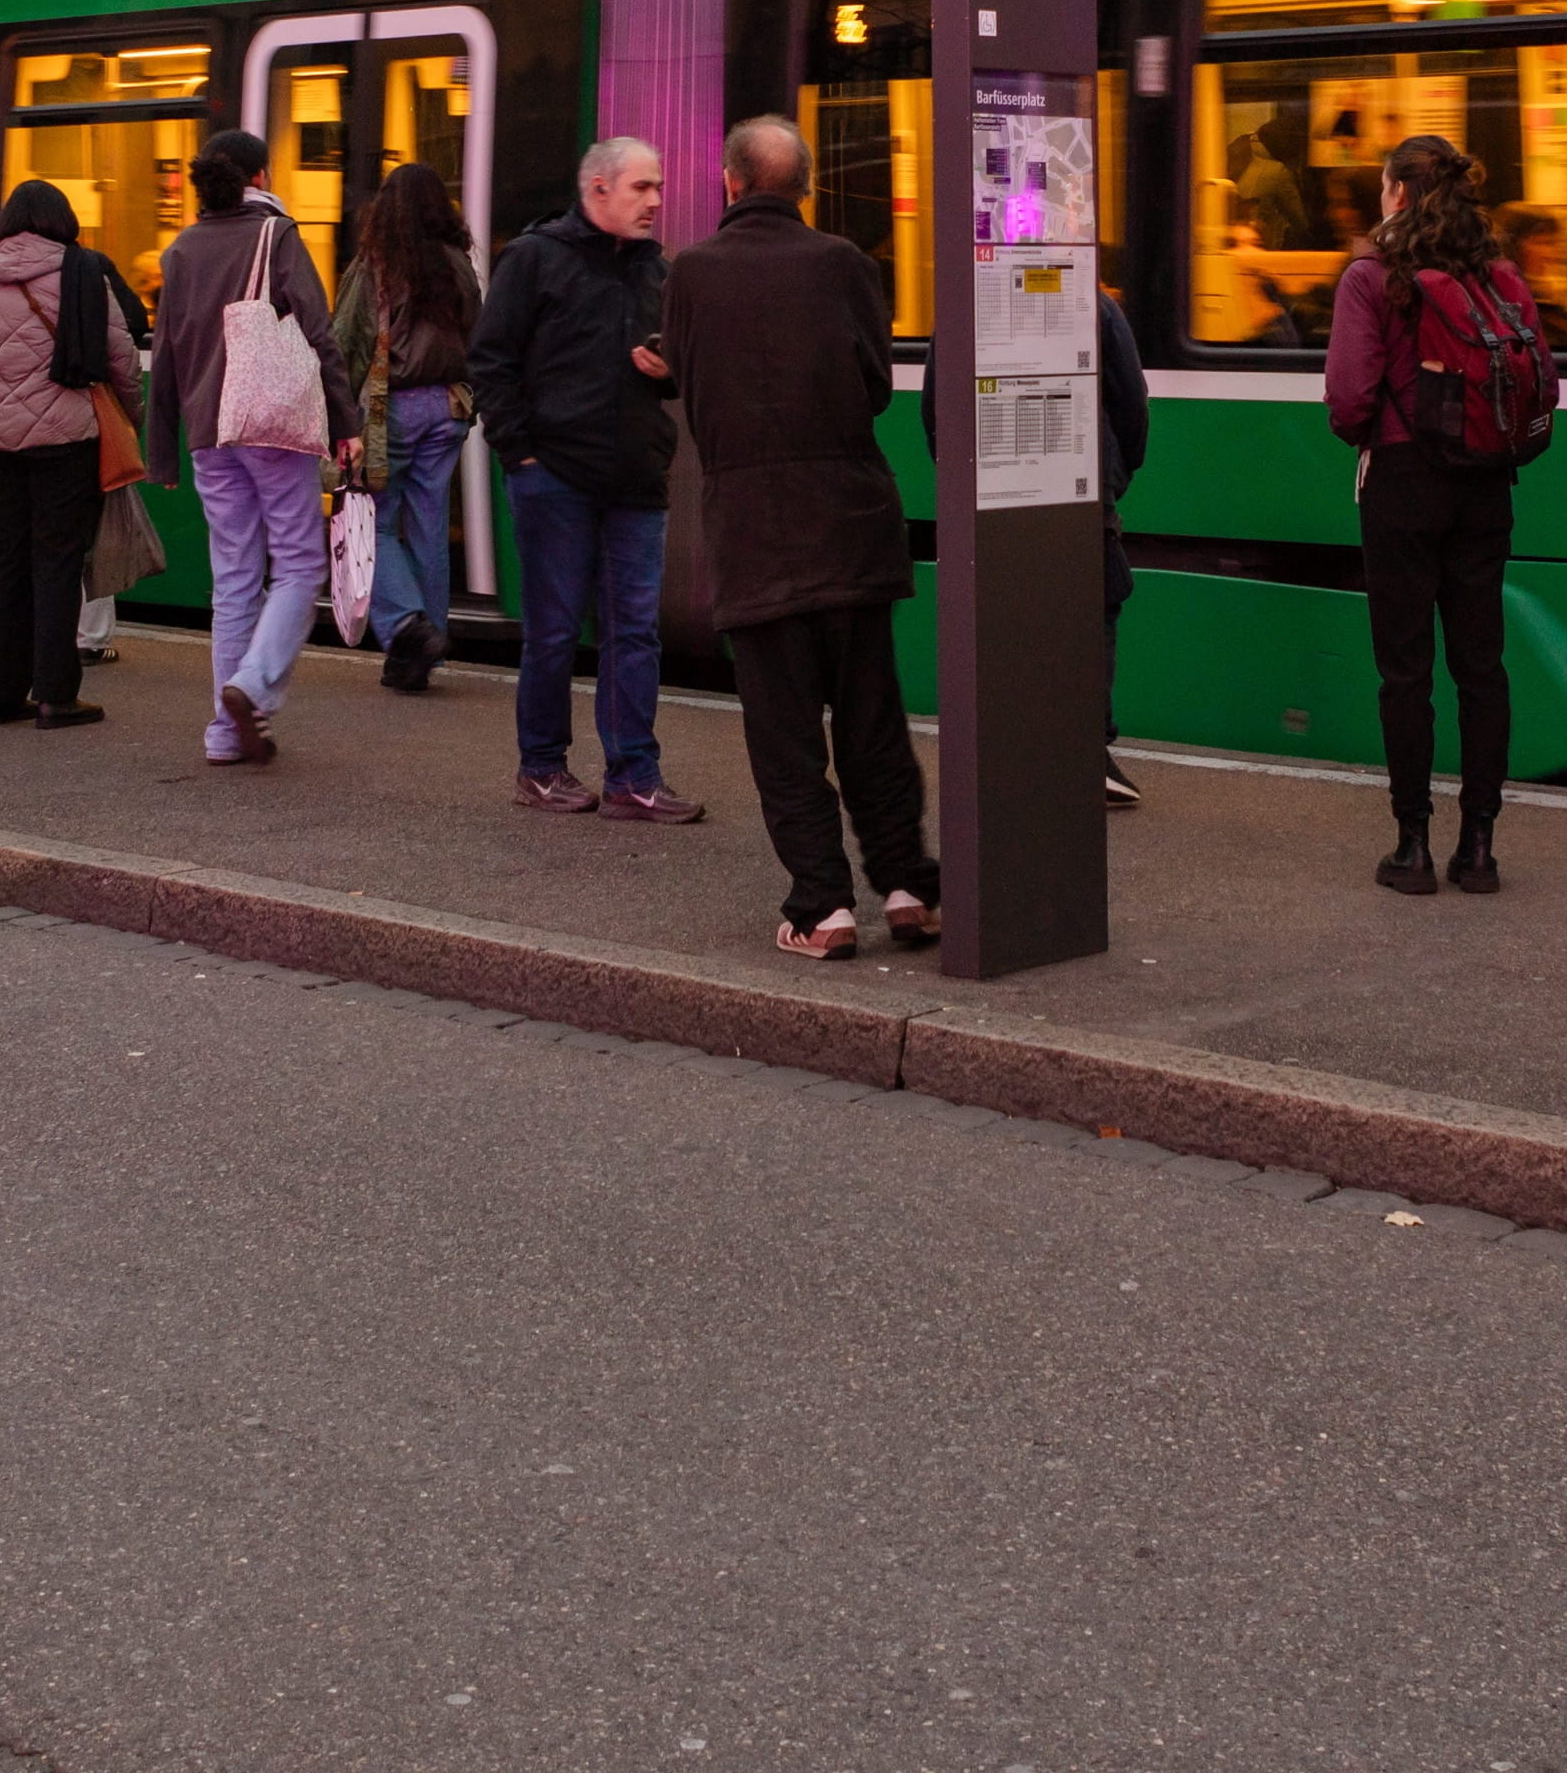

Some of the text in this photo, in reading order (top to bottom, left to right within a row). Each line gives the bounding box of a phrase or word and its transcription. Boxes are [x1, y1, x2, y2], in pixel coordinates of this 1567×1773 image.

[976, 89, 1047, 110] Barfüsserplatz
[979, 248, 991, 261] 14
[982, 380, 994, 393] 16
